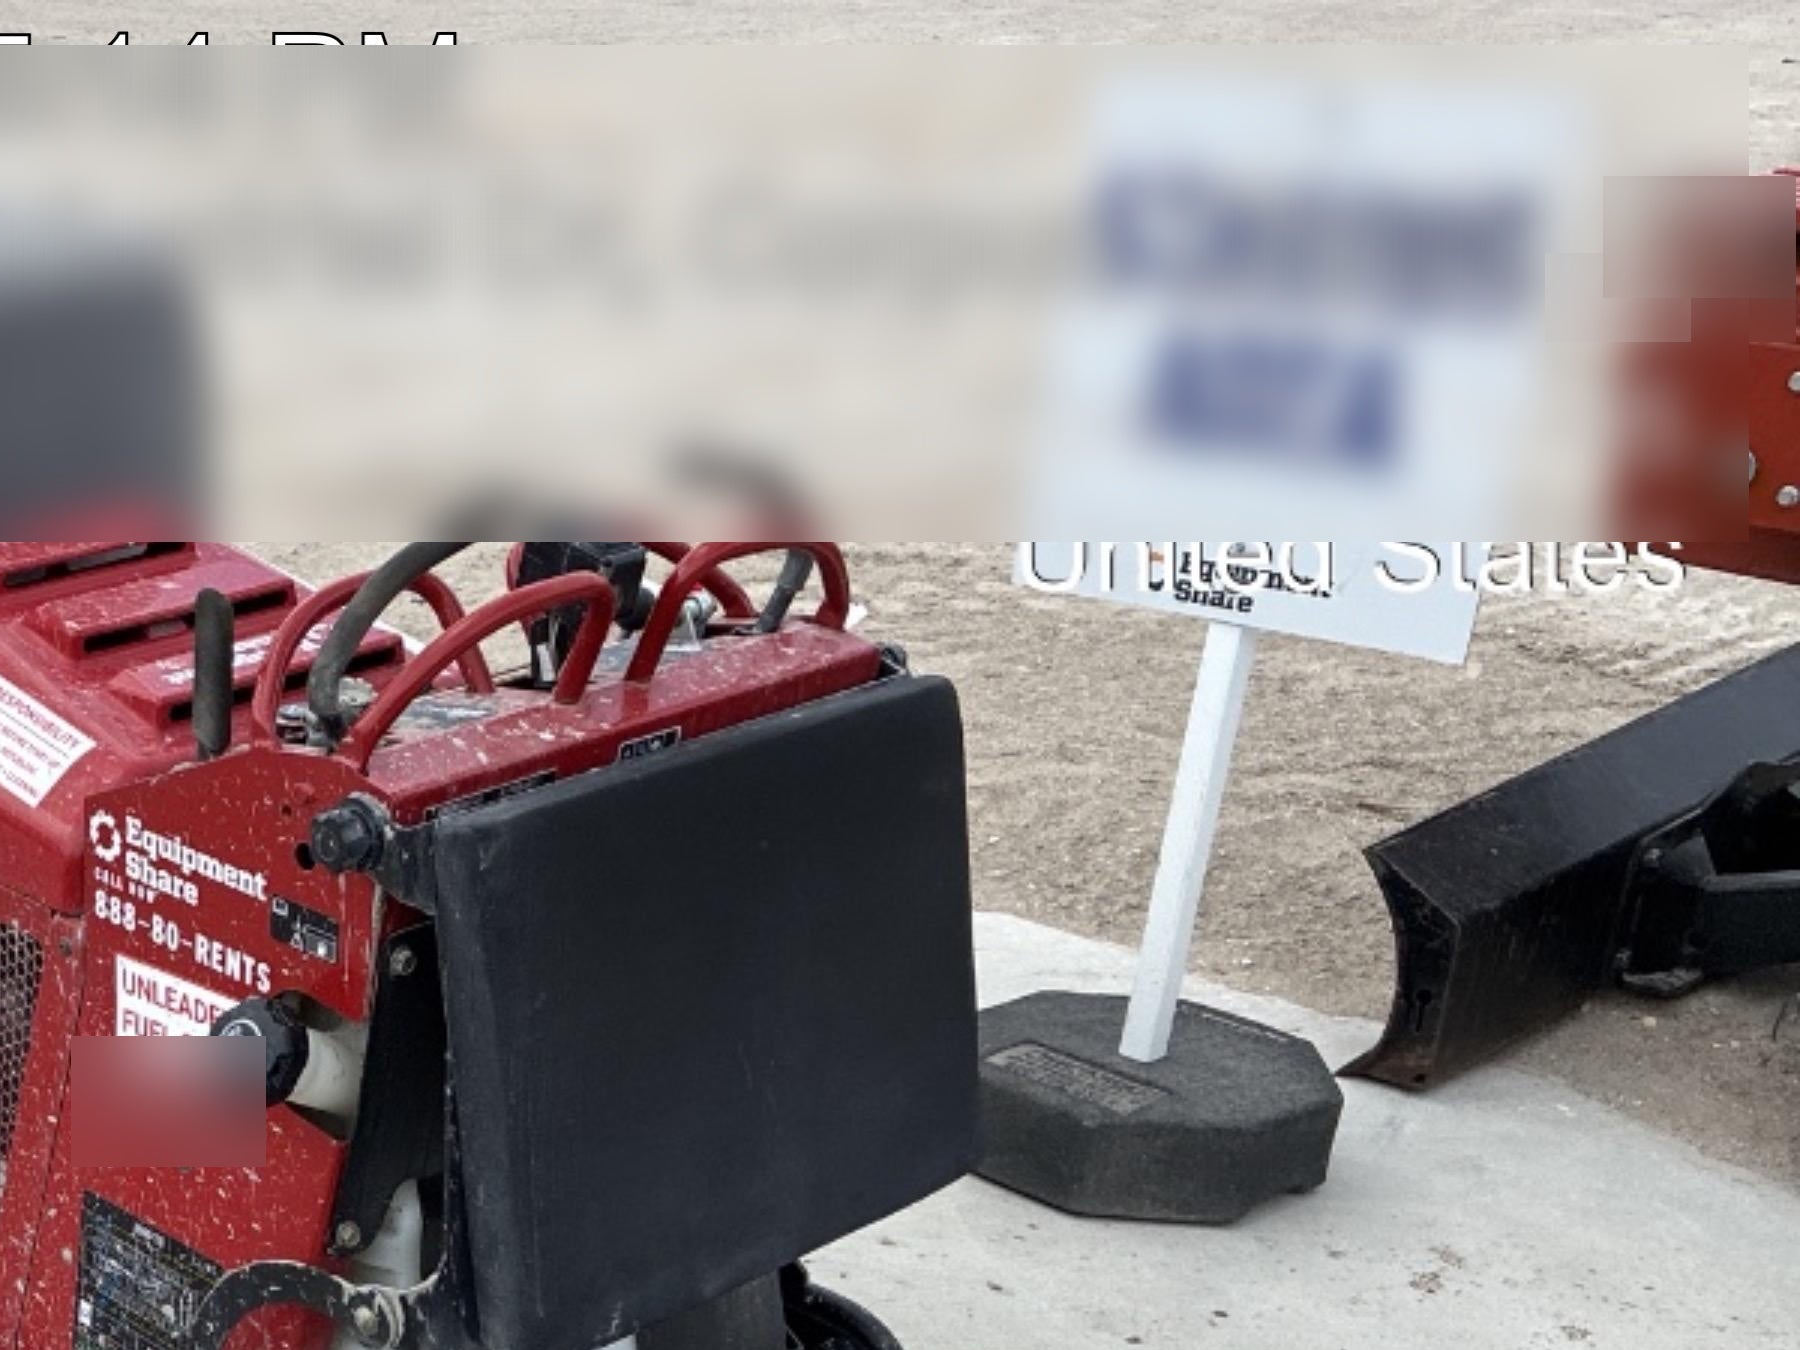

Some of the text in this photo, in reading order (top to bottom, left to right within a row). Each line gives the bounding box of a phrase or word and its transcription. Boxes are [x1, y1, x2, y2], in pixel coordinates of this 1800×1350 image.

[124, 815, 267, 901] Equipment
[125, 850, 199, 906] Share
[94, 889, 271, 994] 888-80-RENTS
[122, 967, 224, 1024] UNLEADE
